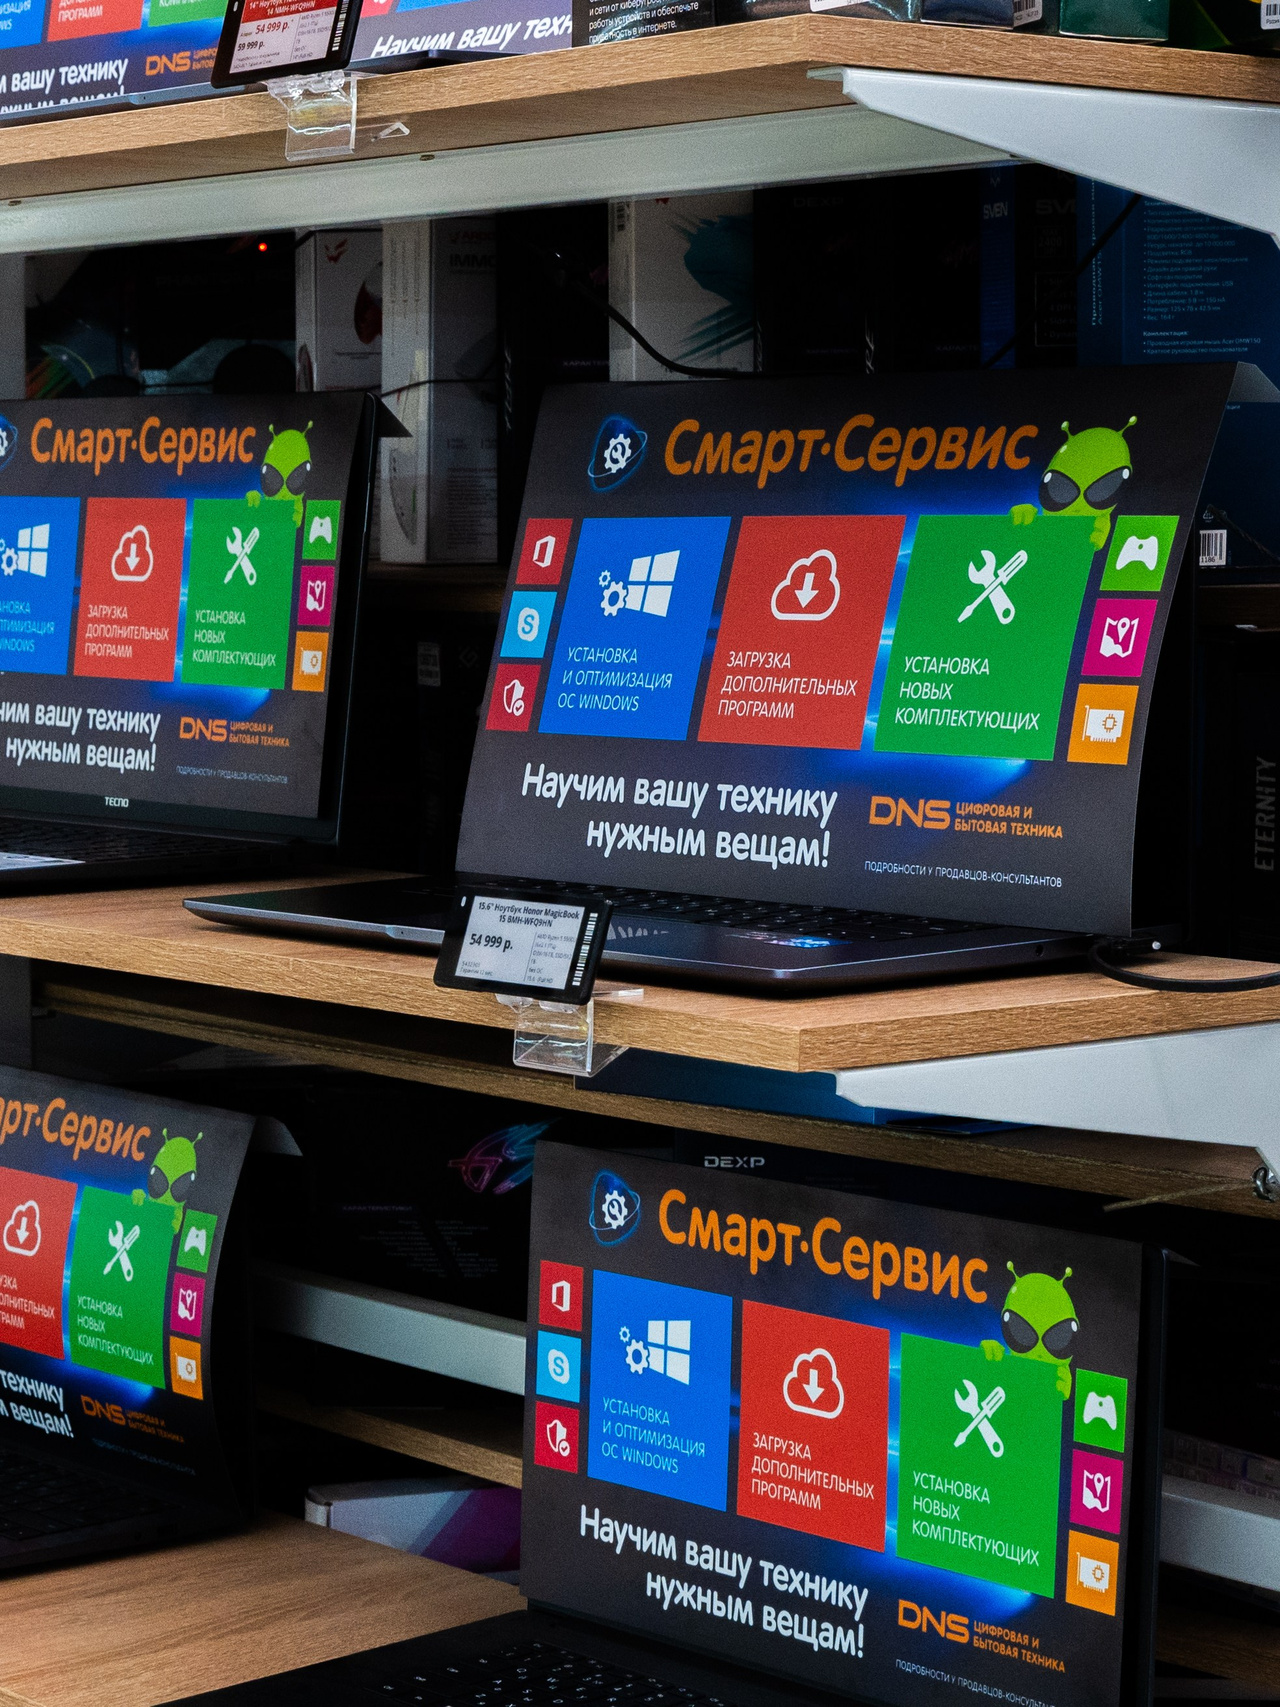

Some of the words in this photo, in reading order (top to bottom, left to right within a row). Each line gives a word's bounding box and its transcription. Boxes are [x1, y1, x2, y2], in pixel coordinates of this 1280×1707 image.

[57, 5, 103, 23] ПРОГРАММ
[588, 17, 614, 31] работы
[651, 9, 657, 17] и
[657, 2, 699, 17] обеспечьте
[589, 8, 594, 17] и
[594, 5, 610, 16] сети
[610, 3, 620, 12] от
[255, 25, 265, 35] 54
[266, 22, 281, 33] 999
[456, 21, 522, 51] вашу
[633, 28, 638, 36] в
[638, 20, 678, 34] интернете.
[237, 43, 246, 51] 59
[246, 40, 258, 50] 999
[145, 51, 192, 76] DNS
[10, 67, 55, 95] вашу
[58, 58, 129, 86] технику
[983, 201, 1008, 220] SVEN
[87, 604, 128, 619] ЗАГРУЗКА
[195, 609, 246, 625] УСТАНОВКА
[85, 623, 169, 640] ДОПОЛНИТЕЛЬНЫХ
[193, 629, 226, 644] НОВЫХ
[84, 642, 132, 657] ПРОГРАММ
[192, 649, 276, 668] КОМПЛЕКТУЮЩИХ
[567, 646, 637, 663] УСТАНОВКА
[727, 650, 791, 668] ЗАГРУЗКА
[904, 656, 989, 675] УСТАНОВКА
[562, 670, 573, 684] И
[575, 669, 673, 691] ОПТИМИЗАЦИЯ
[720, 675, 857, 696] ДОПОЛНИТЕЛЬНЫХ
[899, 682, 953, 700] НОВЫХ
[557, 692, 576, 708] ОС
[579, 694, 639, 711] WINDOWS
[717, 699, 794, 718] ПРОГРАММ
[34, 704, 82, 735] вашу
[86, 708, 161, 742] технику
[179, 716, 227, 742] DNS
[894, 707, 1040, 733] КОМПЛЕКТУЮЩИХ
[5, 737, 80, 766] нужным
[85, 743, 156, 774] вещам!
[521, 762, 625, 808] Научим
[633, 778, 709, 819] вашу
[716, 783, 838, 829] технику
[869, 796, 950, 829] DNS
[956, 802, 1020, 818] ЦИФРОВАЯ
[1023, 805, 1033, 818] И
[954, 818, 1007, 833] БЫТОВАЯ
[1011, 822, 1063, 837] ТЕХНИКА
[586, 820, 705, 858] нужным
[715, 830, 830, 870] вещам!
[864, 860, 927, 876] ПОДРОБНОСТИ
[927, 865, 935, 875] У
[935, 866, 1063, 888] ПРОДАВЦОВ-КОНСУЛЬТАНТОВ
[478, 901, 494, 911] 15.6"
[494, 904, 522, 916] Ноутбук
[522, 906, 544, 917] Honor
[544, 908, 580, 921] MagicBook
[499, 914, 507, 923] 15
[470, 933, 484, 946] 54
[484, 935, 502, 948] 999
[502, 938, 513, 953] р.
[704, 1156, 765, 1168] DEXP
[77, 1295, 123, 1318] УСТАНОВКА
[77, 1314, 105, 1332] НОВЫХ
[77, 1333, 154, 1365] КОМПЛЕКТУЮЩИХ
[9, 1401, 75, 1438] вещам!
[81, 1394, 126, 1426] DNS
[603, 1397, 670, 1426] УСТАНОВКА
[602, 1419, 611, 1434] И
[614, 1422, 705, 1457] ОПТИМИЗАЦИЯ
[752, 1432, 811, 1460] ЗАГРУЗКА
[601, 1441, 618, 1459] ОС
[622, 1446, 679, 1474] WINDOWS
[751, 1455, 874, 1499] ДОПОЛНИТЕЛЬНЫХ
[913, 1470, 990, 1504] УСТАНОВКА
[751, 1478, 821, 1510] ПРОГРАММ
[913, 1495, 960, 1521] НОВЫХ
[912, 1519, 1039, 1566] КОМПЛЕКТУЮЩИХ
[580, 1504, 677, 1561] Научим
[685, 1539, 752, 1589] вашу
[759, 1560, 869, 1621] технику
[646, 1571, 753, 1626] нужным
[762, 1605, 864, 1656] вещам!
[898, 1599, 969, 1644] DNS
[973, 1620, 1029, 1646] ЦИФРОВАЯ
[1032, 1637, 1040, 1649] И
[973, 1636, 1018, 1659] БЫТОВАЯ
[1021, 1649, 1066, 1673] ТЕХНИКА
[895, 1658, 951, 1683] ПОДРОБНОСТИ
[951, 1675, 957, 1684] У
